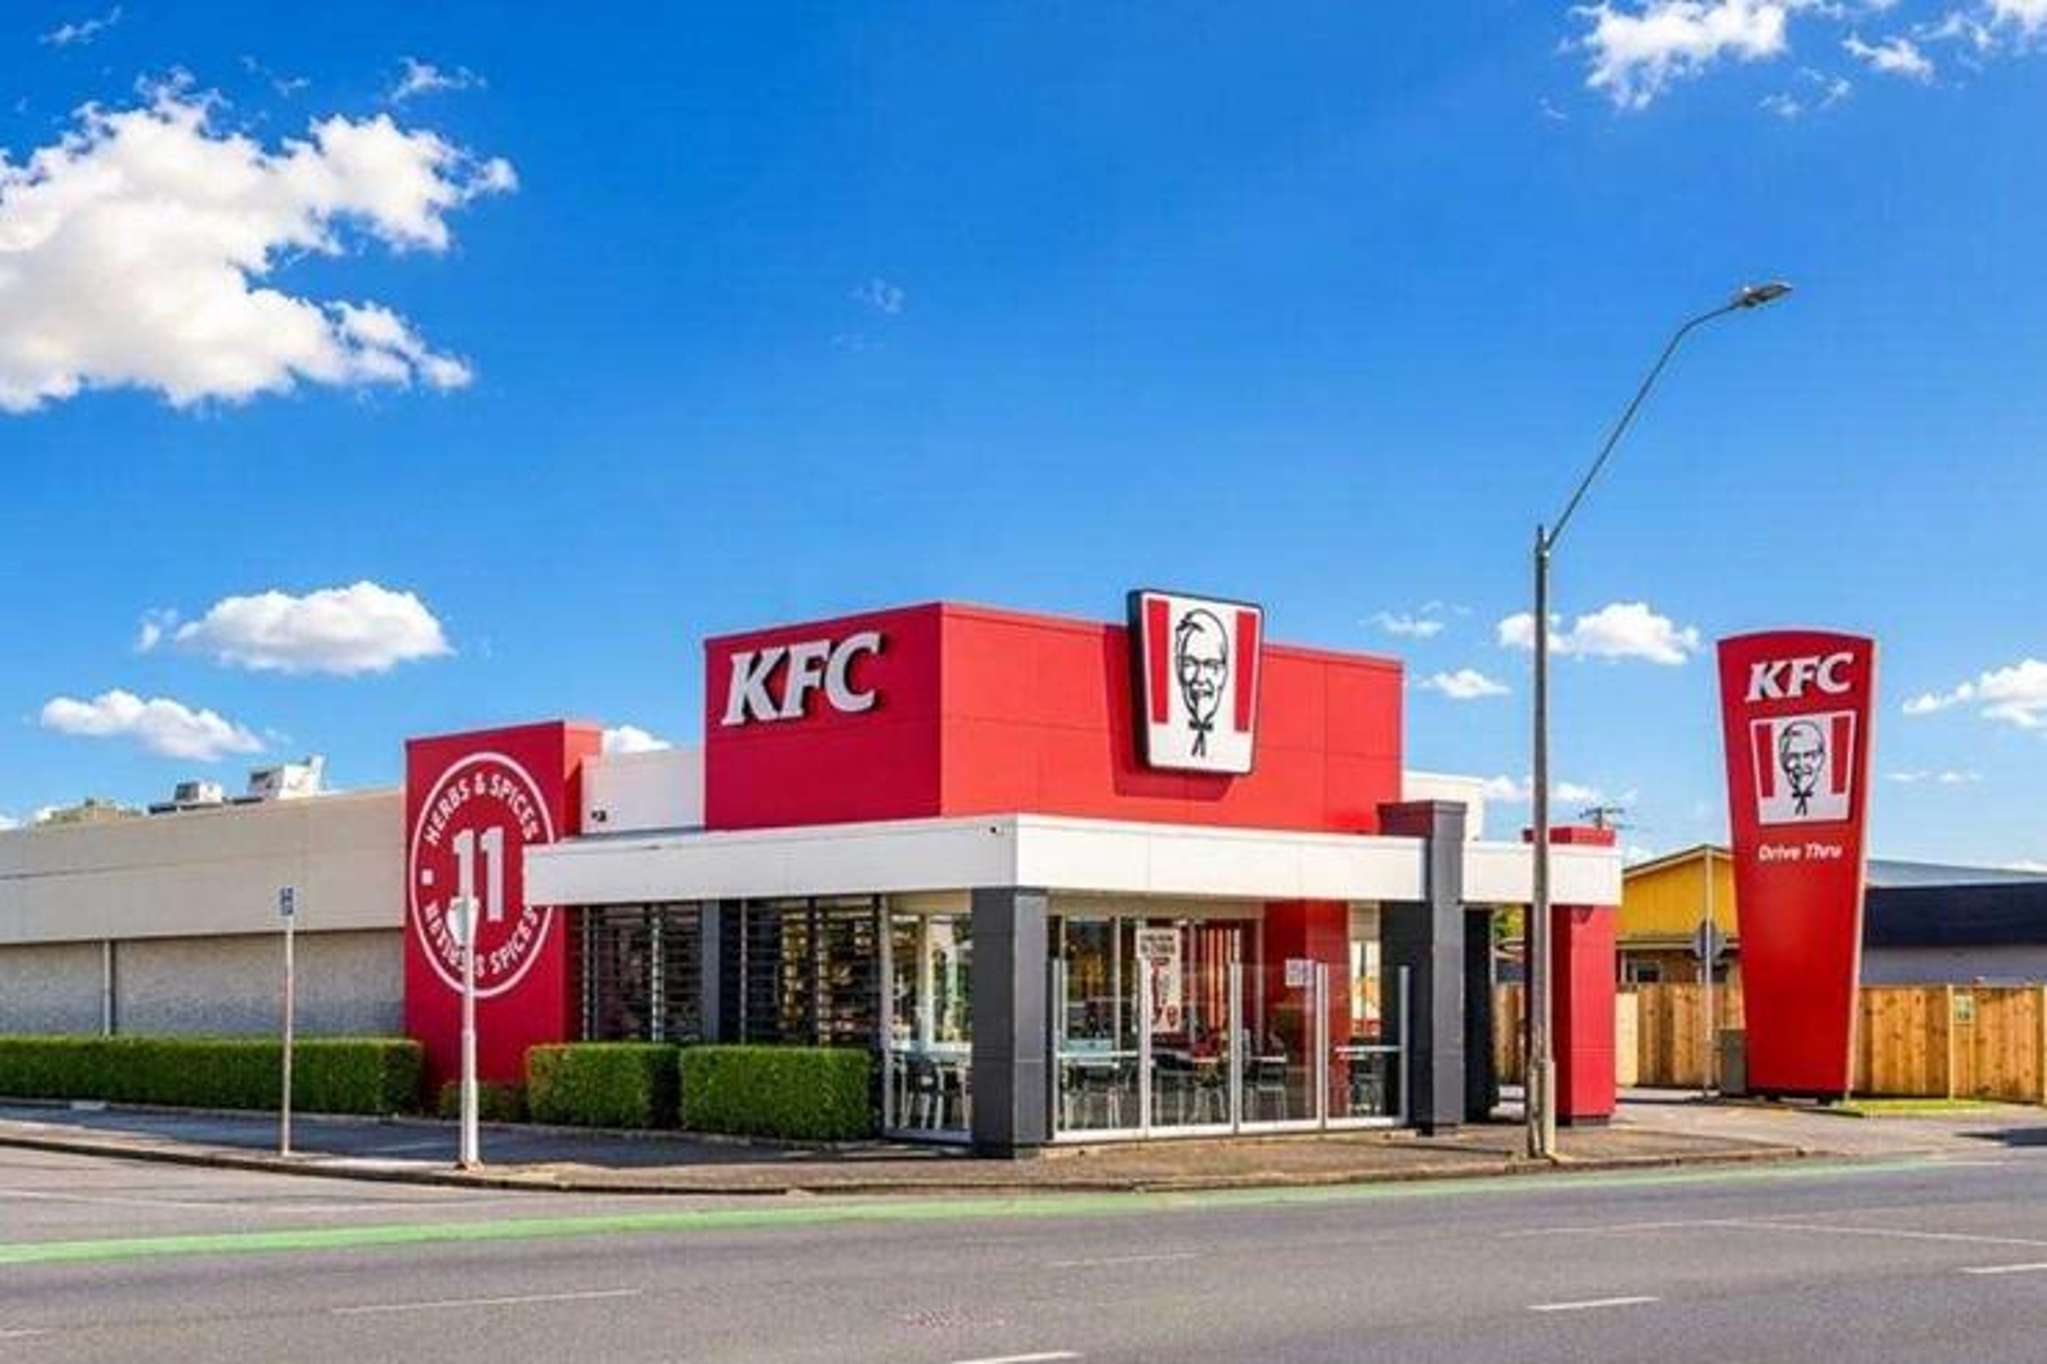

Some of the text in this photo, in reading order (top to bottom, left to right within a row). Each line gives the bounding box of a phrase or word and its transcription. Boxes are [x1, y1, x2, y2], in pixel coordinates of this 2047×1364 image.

[721, 631, 880, 726] KFC
[1745, 652, 1853, 703] KFC
[423, 772, 539, 846] HERBS & SPICES
[453, 826, 504, 922] 11
[1758, 841, 1843, 861] Drive Thru
